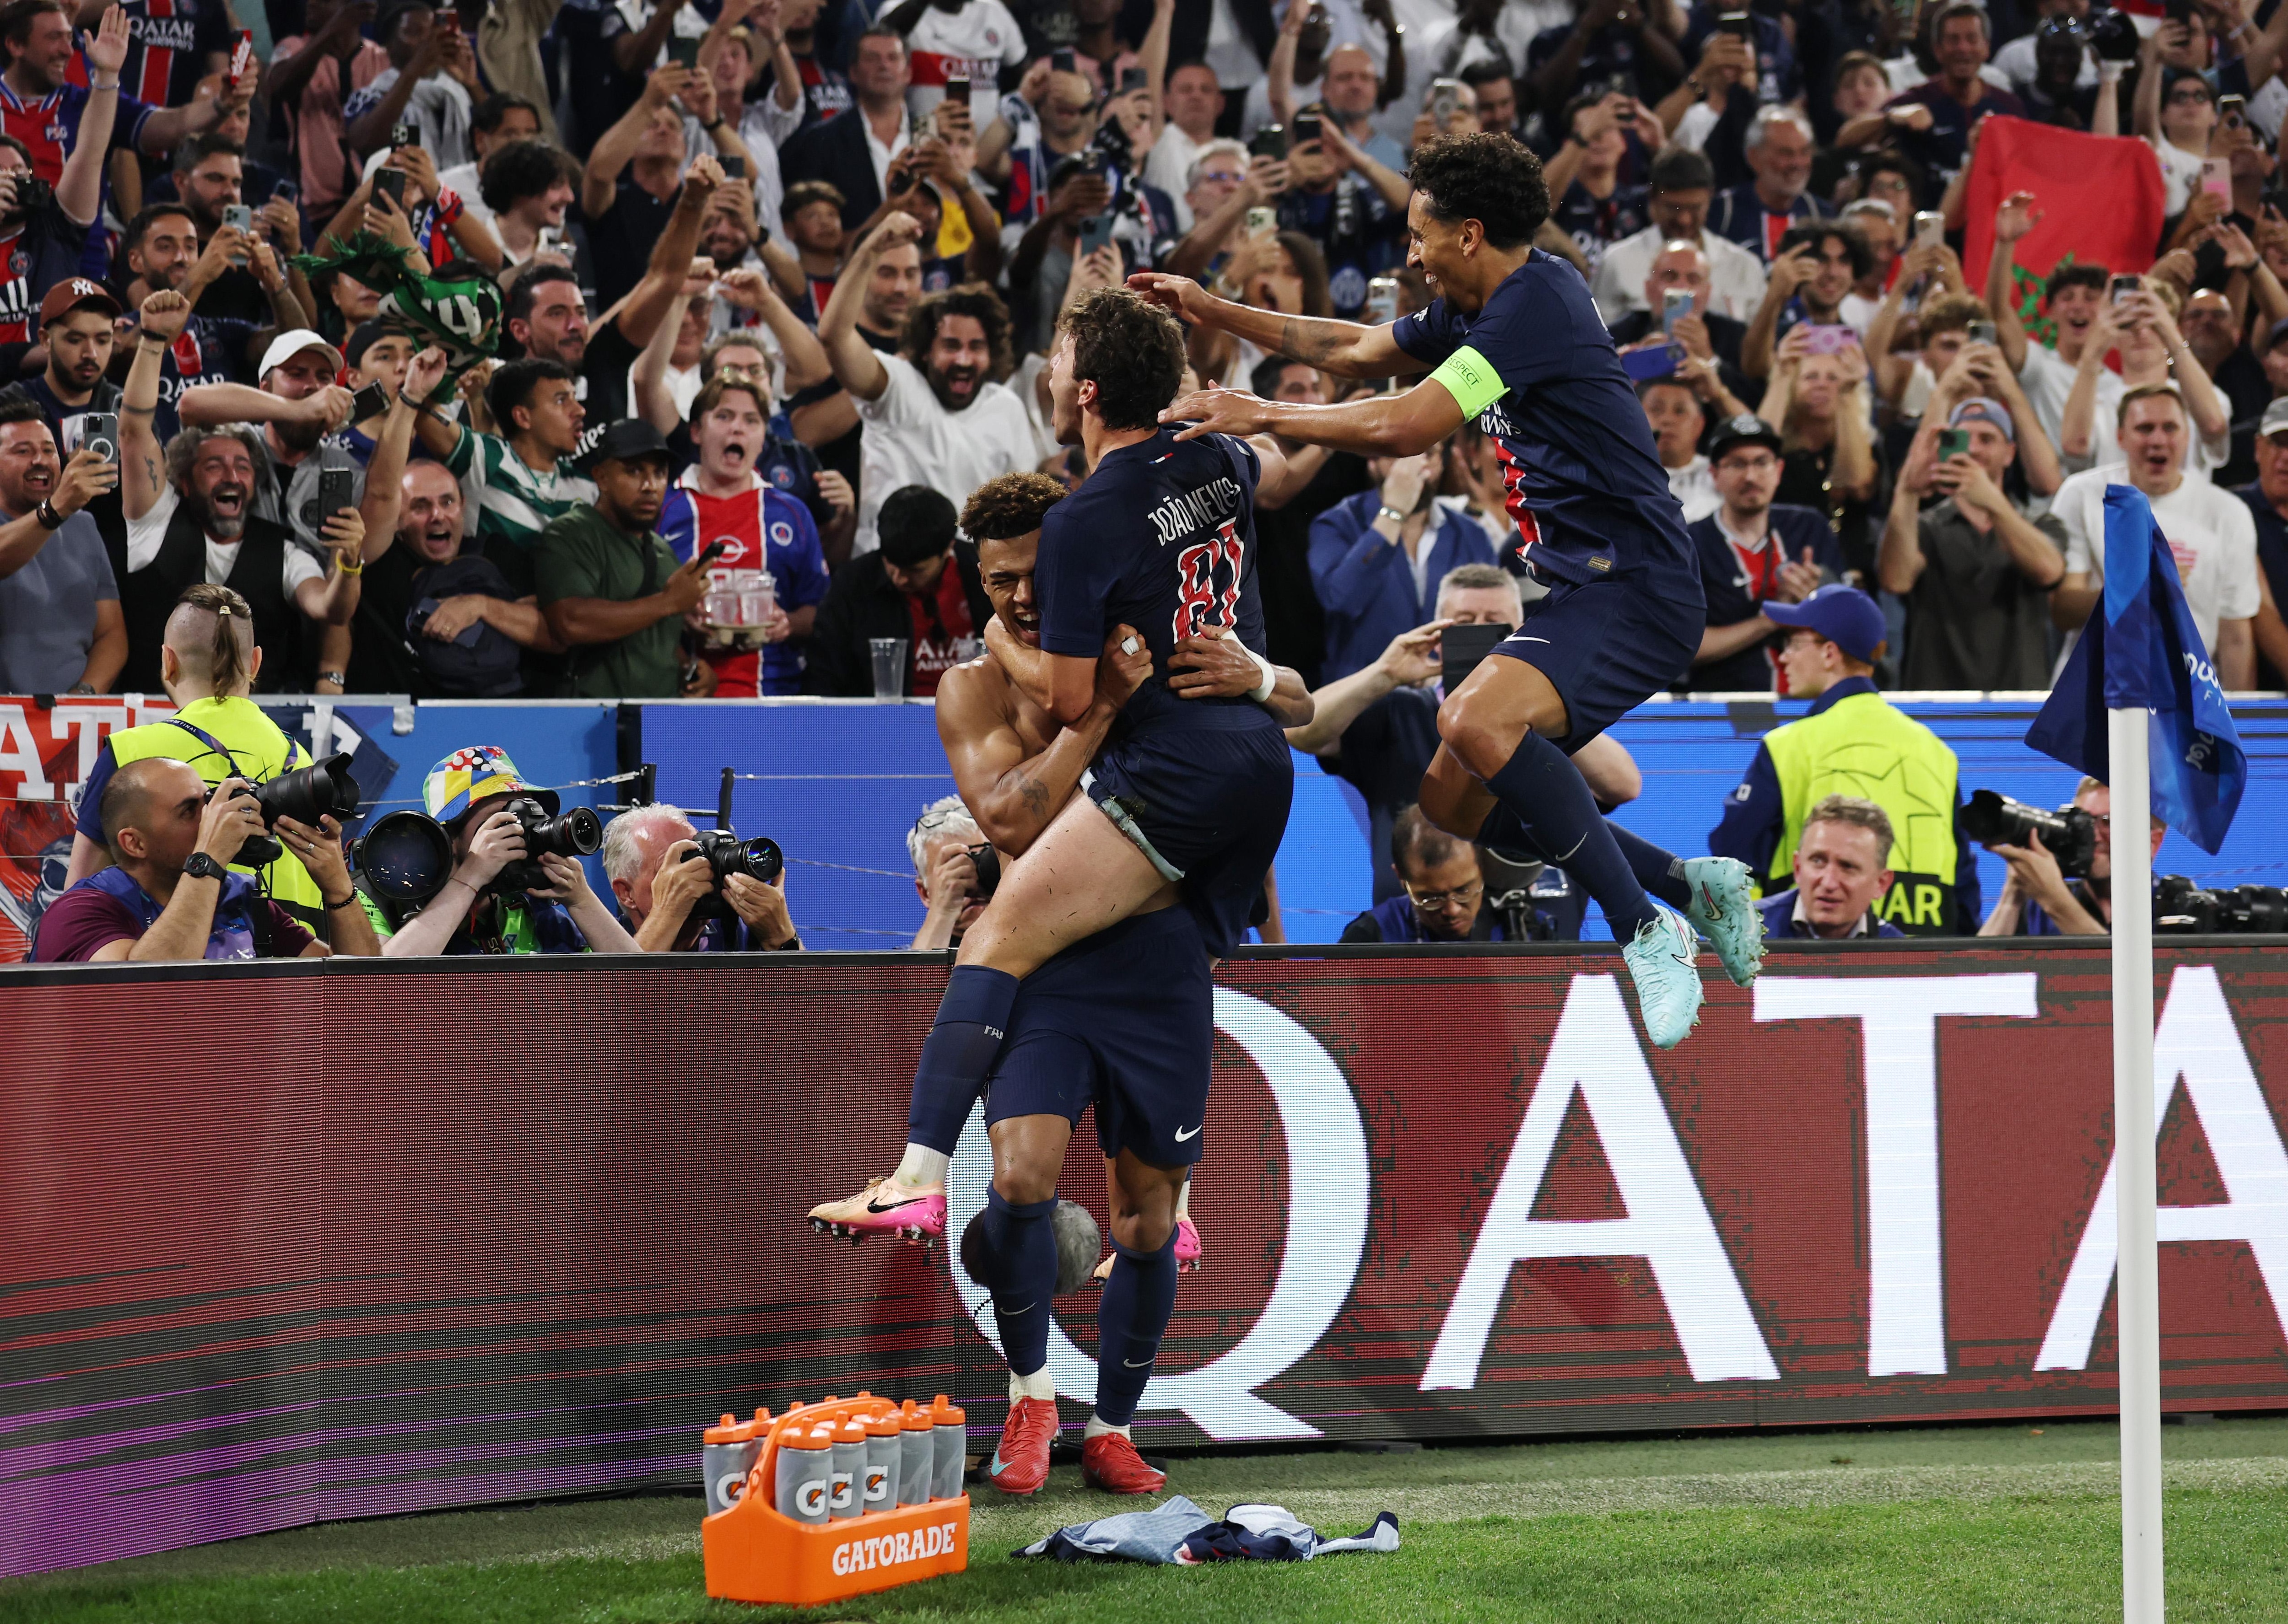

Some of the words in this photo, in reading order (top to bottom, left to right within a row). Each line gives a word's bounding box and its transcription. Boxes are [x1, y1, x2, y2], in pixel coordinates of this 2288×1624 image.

[128, 15, 195, 40] QATAR
[1446, 357, 1479, 385] RESPECT
[1148, 495, 1195, 546] JOÃO
[1172, 516, 1245, 644] 87
[179, 721, 196, 733] FINAL
[795, 1479, 827, 1517] G
[832, 1522, 957, 1576] GATORADE
